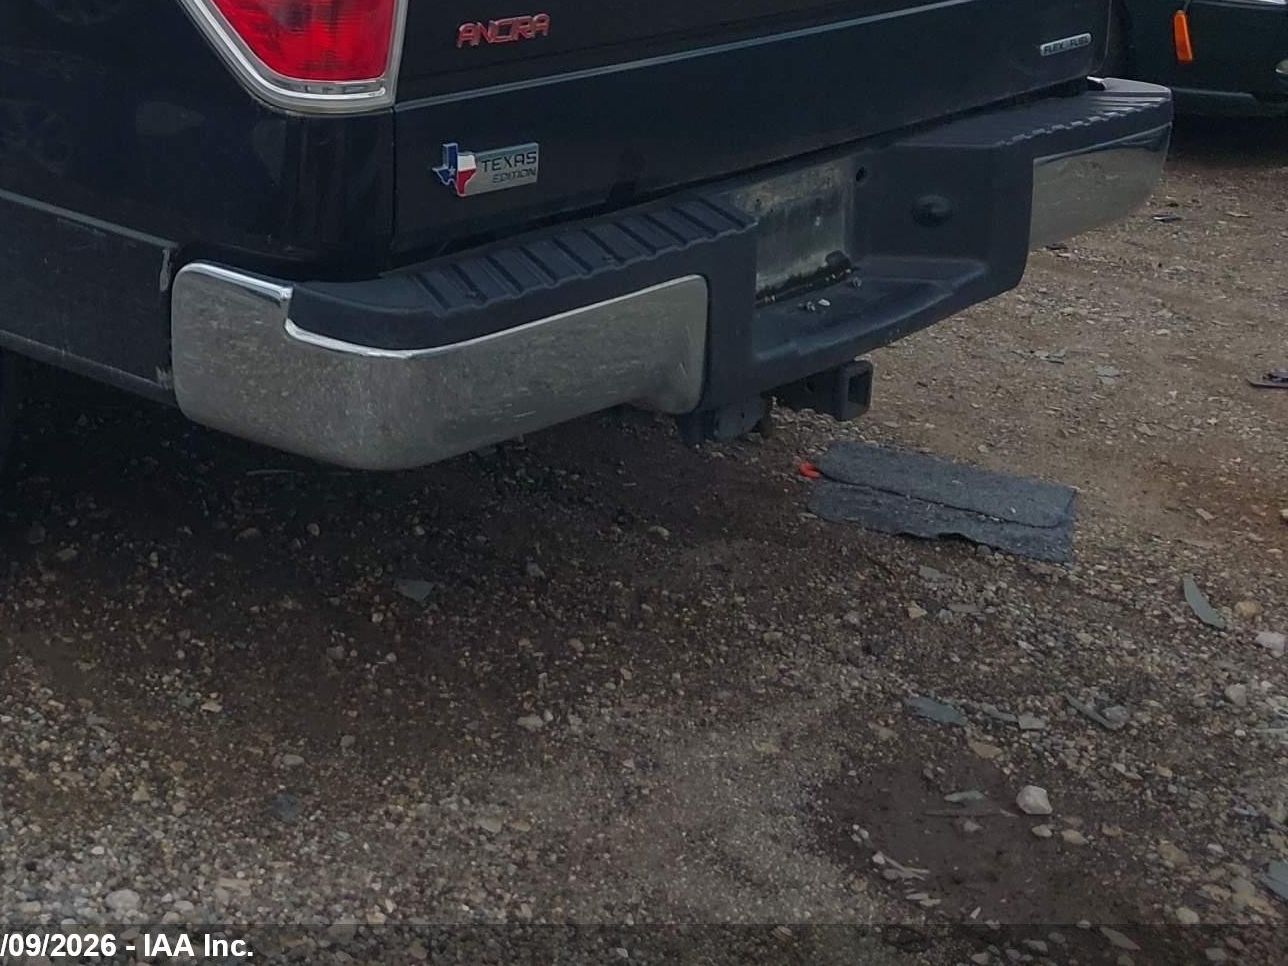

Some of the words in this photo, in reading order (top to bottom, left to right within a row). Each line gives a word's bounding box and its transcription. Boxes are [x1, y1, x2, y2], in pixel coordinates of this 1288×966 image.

[1043, 41, 1064, 53] FLEX
[481, 151, 537, 172] TEXAS
[492, 167, 537, 183] EDITION
